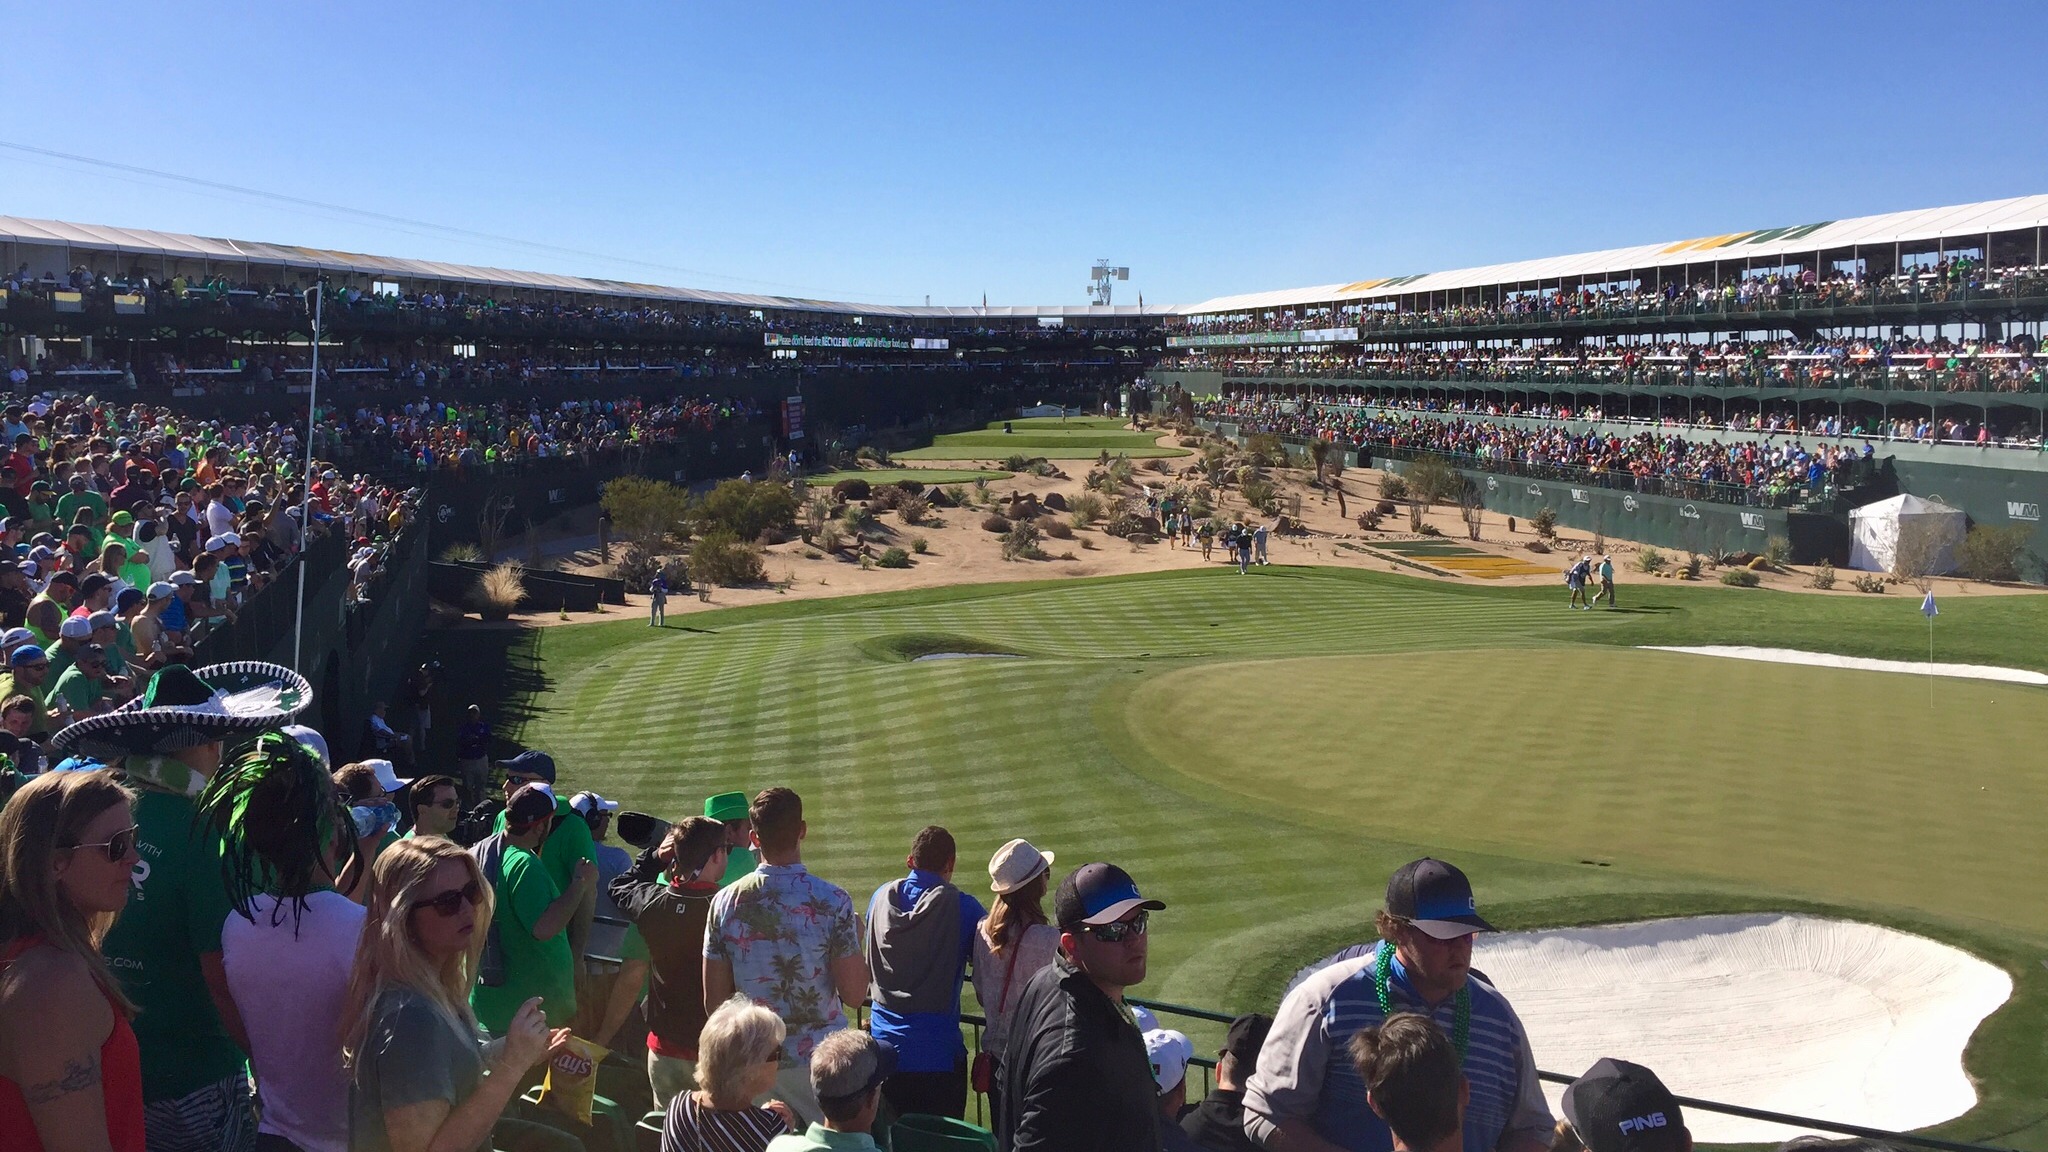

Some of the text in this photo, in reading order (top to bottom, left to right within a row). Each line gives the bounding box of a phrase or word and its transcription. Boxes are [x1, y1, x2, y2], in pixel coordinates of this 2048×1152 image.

[822, 336, 842, 347] RECYCLE
[2007, 501, 2040, 518] WM
[1740, 512, 1765, 528] WM
[1619, 1112, 1667, 1136] PING
